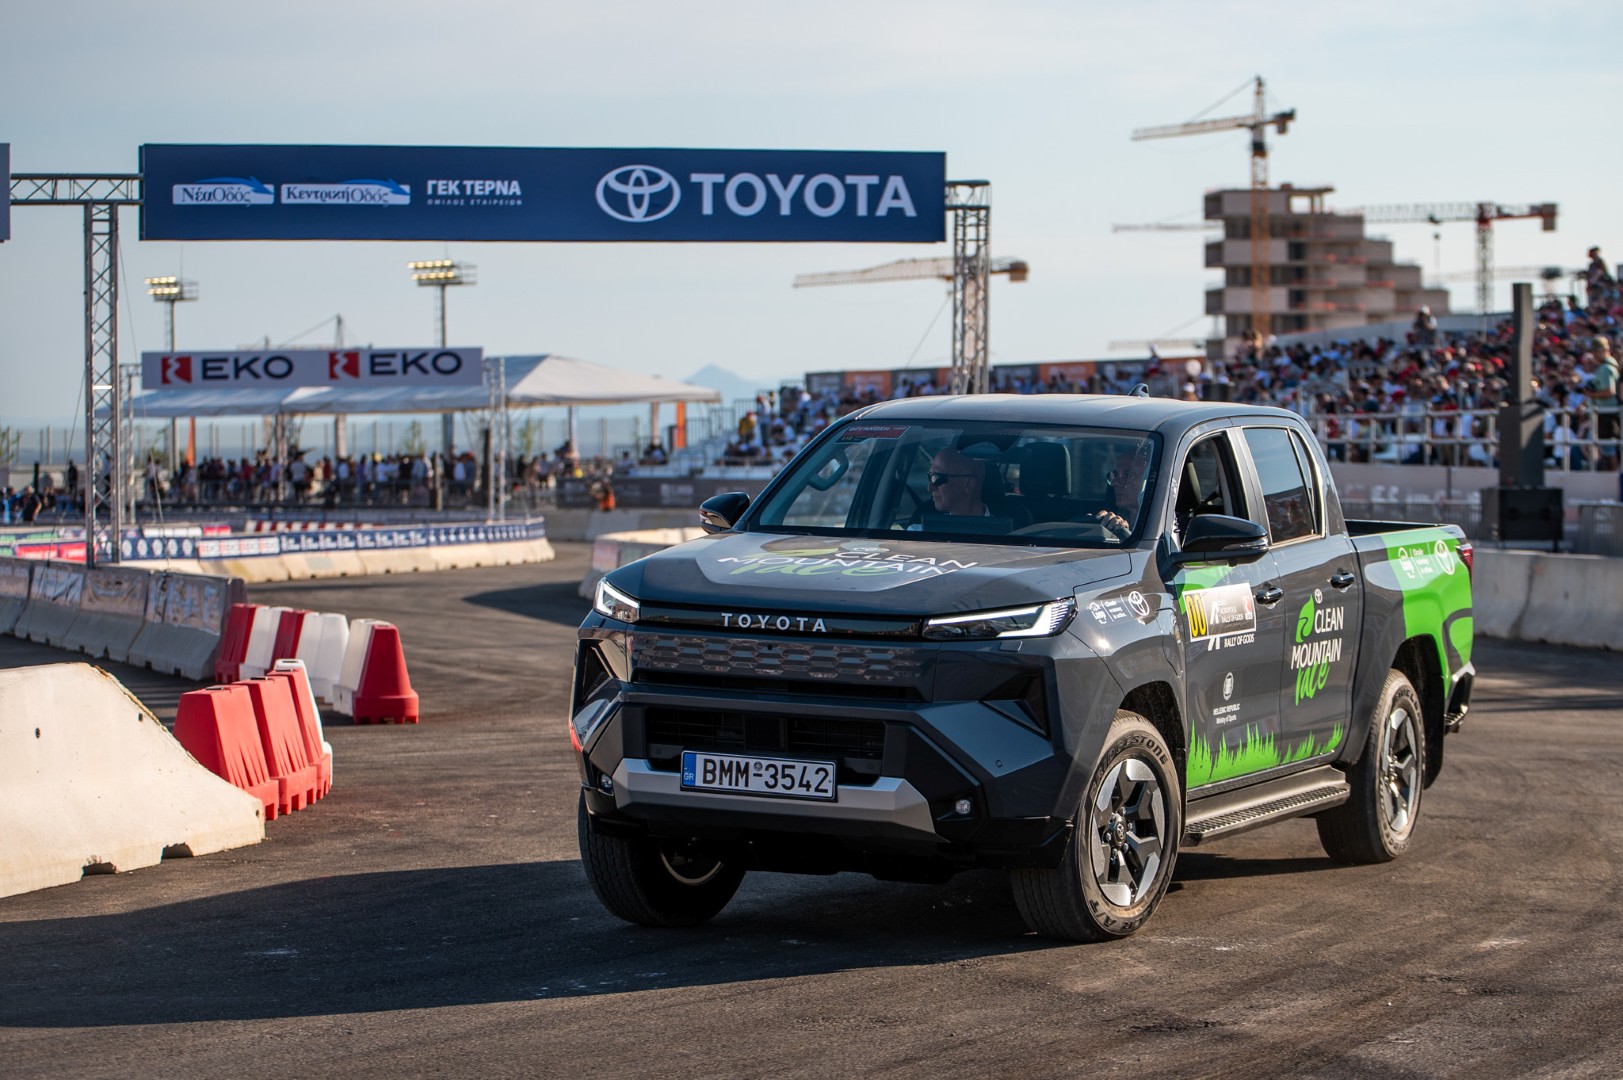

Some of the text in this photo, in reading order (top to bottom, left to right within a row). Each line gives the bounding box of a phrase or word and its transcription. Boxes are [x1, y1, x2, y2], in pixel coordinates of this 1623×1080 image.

[427, 180, 522, 196] ΓΕΚ ΤΕΡΝΑ
[690, 172, 917, 217] TOYOTA
[201, 356, 294, 380] EKO
[369, 351, 463, 376] EKO
[717, 557, 959, 575] MOUNTAIN
[834, 551, 978, 569] CLEAN
[721, 612, 827, 633] TOYOTA
[1315, 606, 1344, 634] CLEAN
[1224, 634, 1254, 648] RALLY OF GODS
[1290, 638, 1342, 670] MOUNTAIN
[1295, 661, 1330, 706] race
[684, 772, 694, 781] GR
[1090, 734, 1168, 803] BRIDGESTONE
